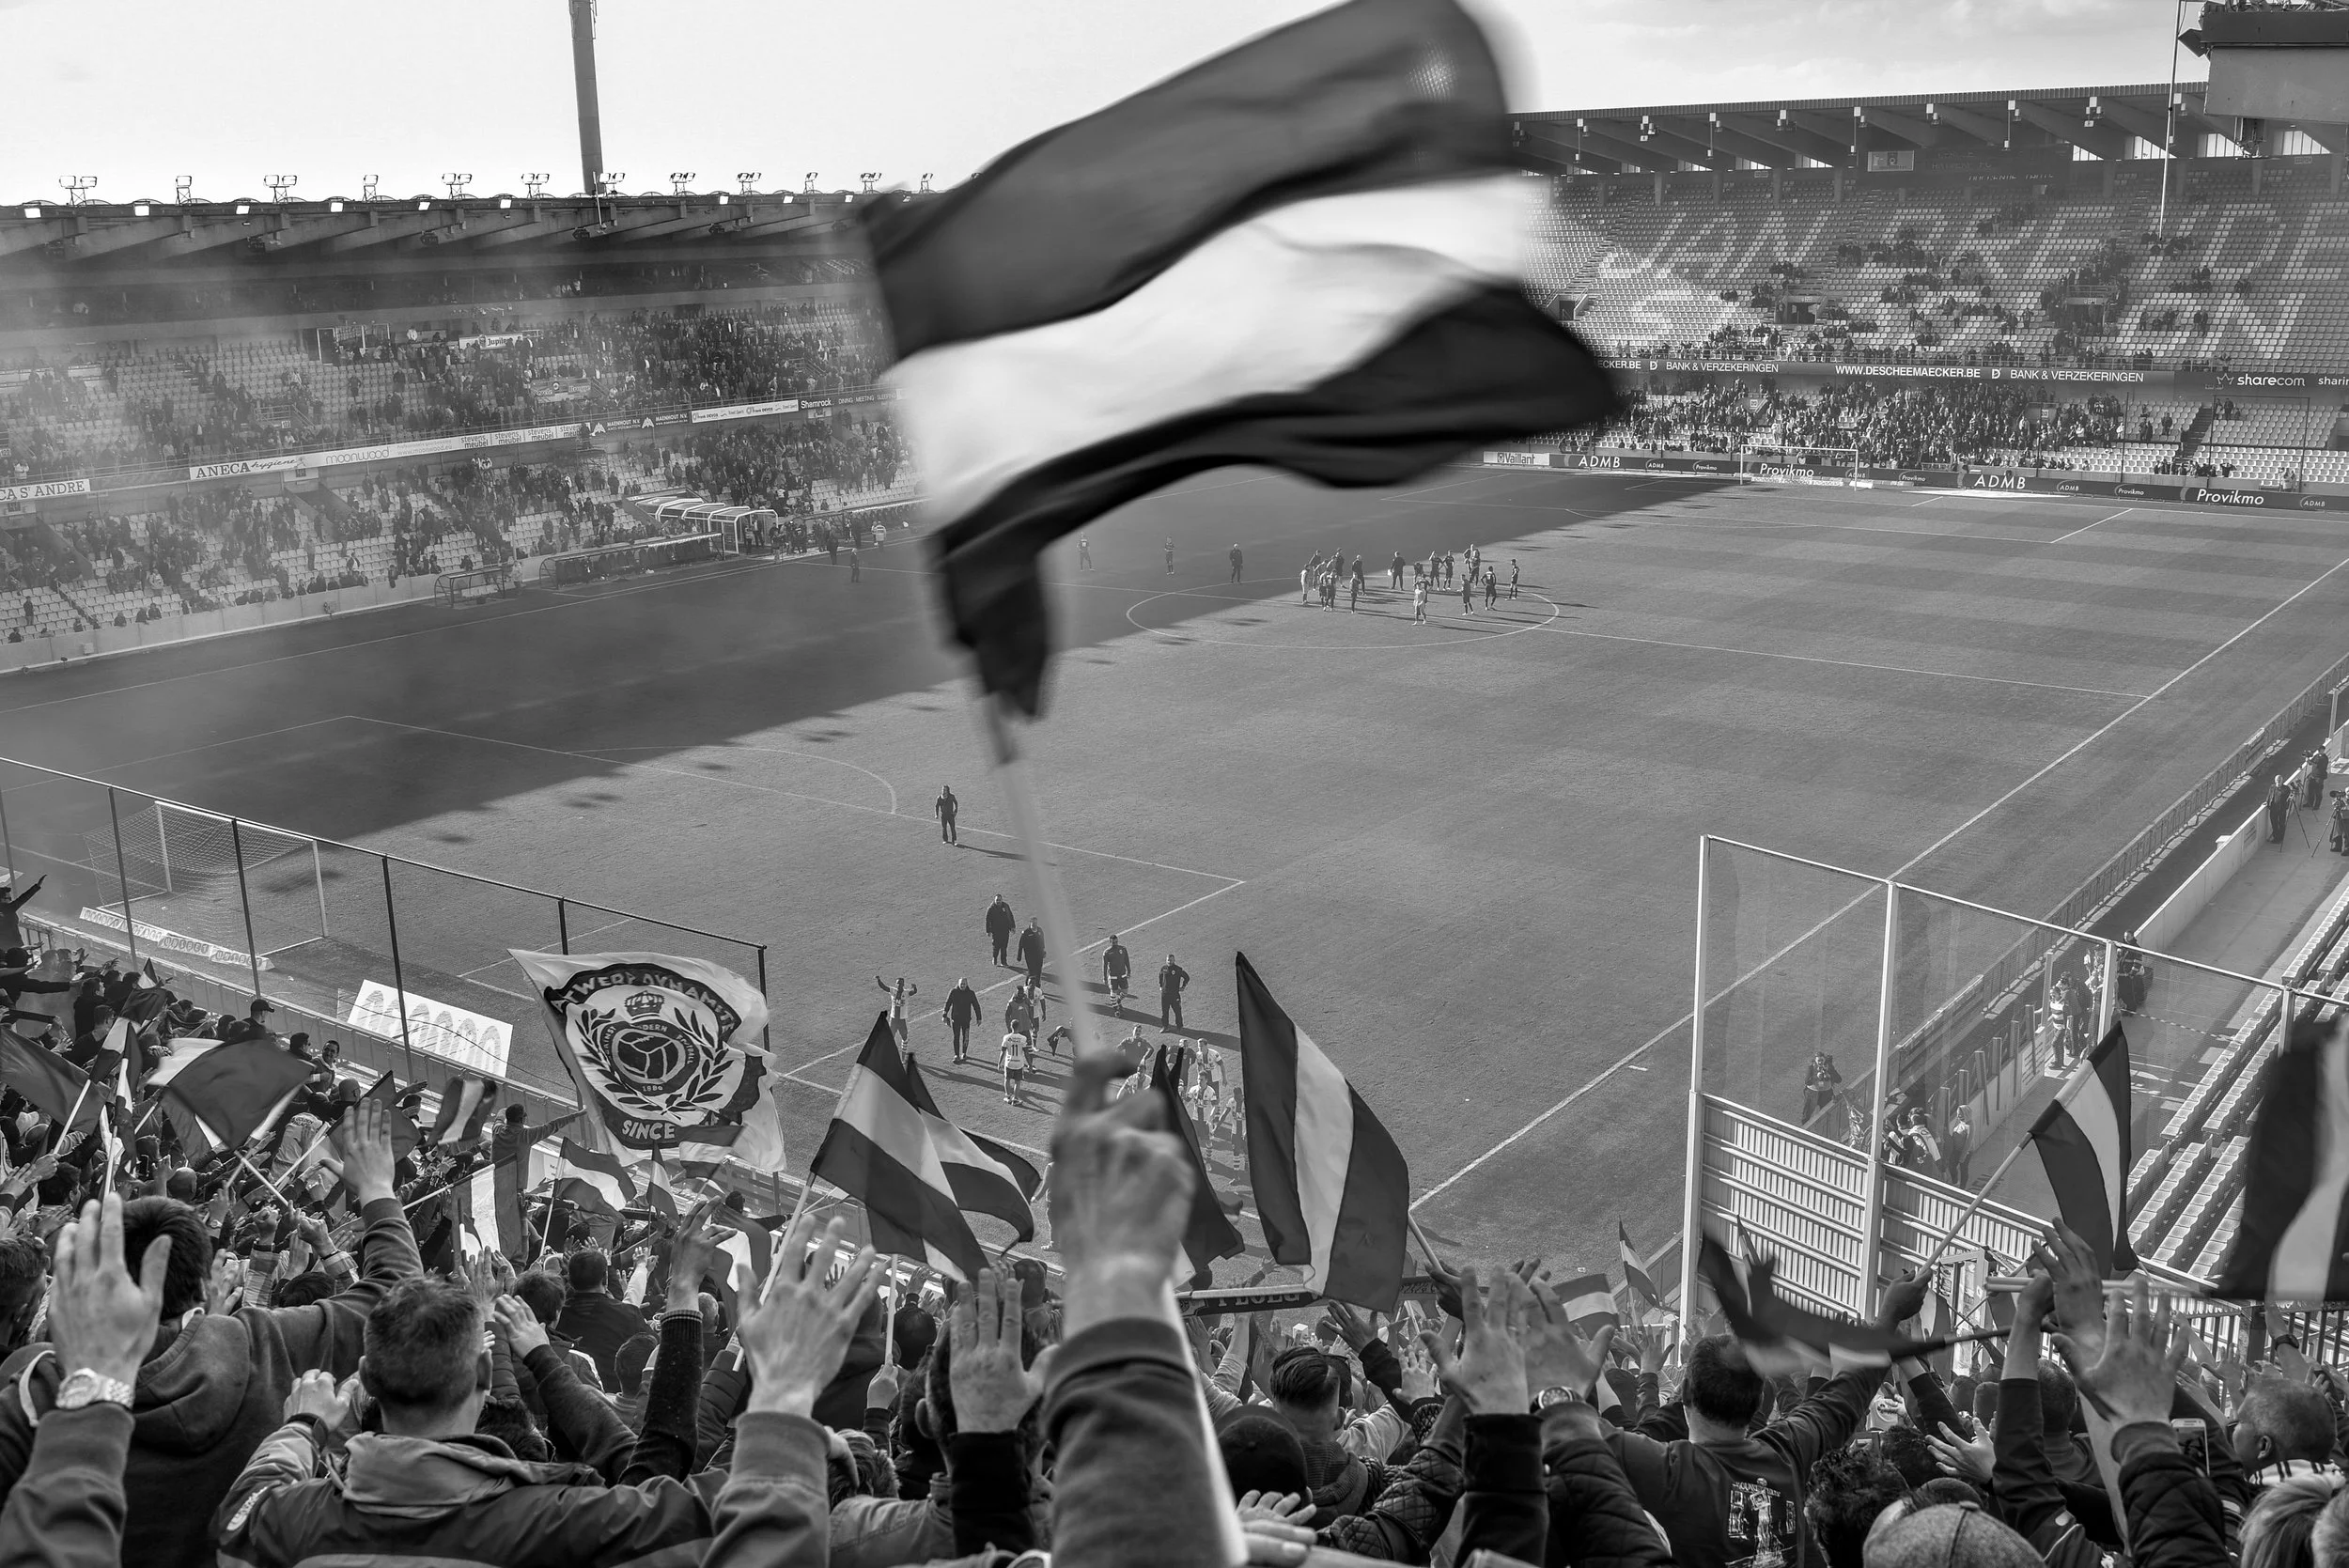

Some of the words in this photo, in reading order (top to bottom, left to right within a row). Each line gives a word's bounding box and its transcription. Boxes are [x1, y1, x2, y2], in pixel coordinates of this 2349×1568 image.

[487, 338, 509, 347] Jupile
[1666, 362, 1691, 371] BANK
[1692, 363, 1699, 371] &
[1700, 363, 1779, 373] VERZEKERINGEN
[1835, 365, 1981, 378] WWW.DESCHEEMAECKER.BE
[2010, 369, 2040, 380] BANK
[2041, 371, 2049, 380] &
[2051, 371, 2144, 382] VERZEKERINGEN
[2237, 373, 2306, 386] sharecom
[801, 398, 832, 409] Shamrock
[527, 427, 552, 437] stevens
[560, 425, 583, 433] steven
[460, 434, 487, 443] stevens
[494, 430, 520, 441] stevens
[499, 436, 522, 445] meubel
[531, 432, 554, 442] meubel
[464, 440, 489, 449] meubel
[326, 446, 390, 464] moonwood
[1504, 453, 1535, 465] Vaillant
[1579, 456, 1621, 468] ADMB
[195, 462, 252, 479] ANECA
[251, 458, 297, 470] hygiene
[1760, 463, 1814, 477] Provikmo
[1974, 474, 2027, 489] ADMB
[34, 480, 86, 497] ANDRE
[2118, 488, 2144, 496] Provikmo
[2196, 489, 2264, 505] Provikmo
[1012, 1044, 1019, 1057] 11
[622, 1120, 676, 1141] SINCE
